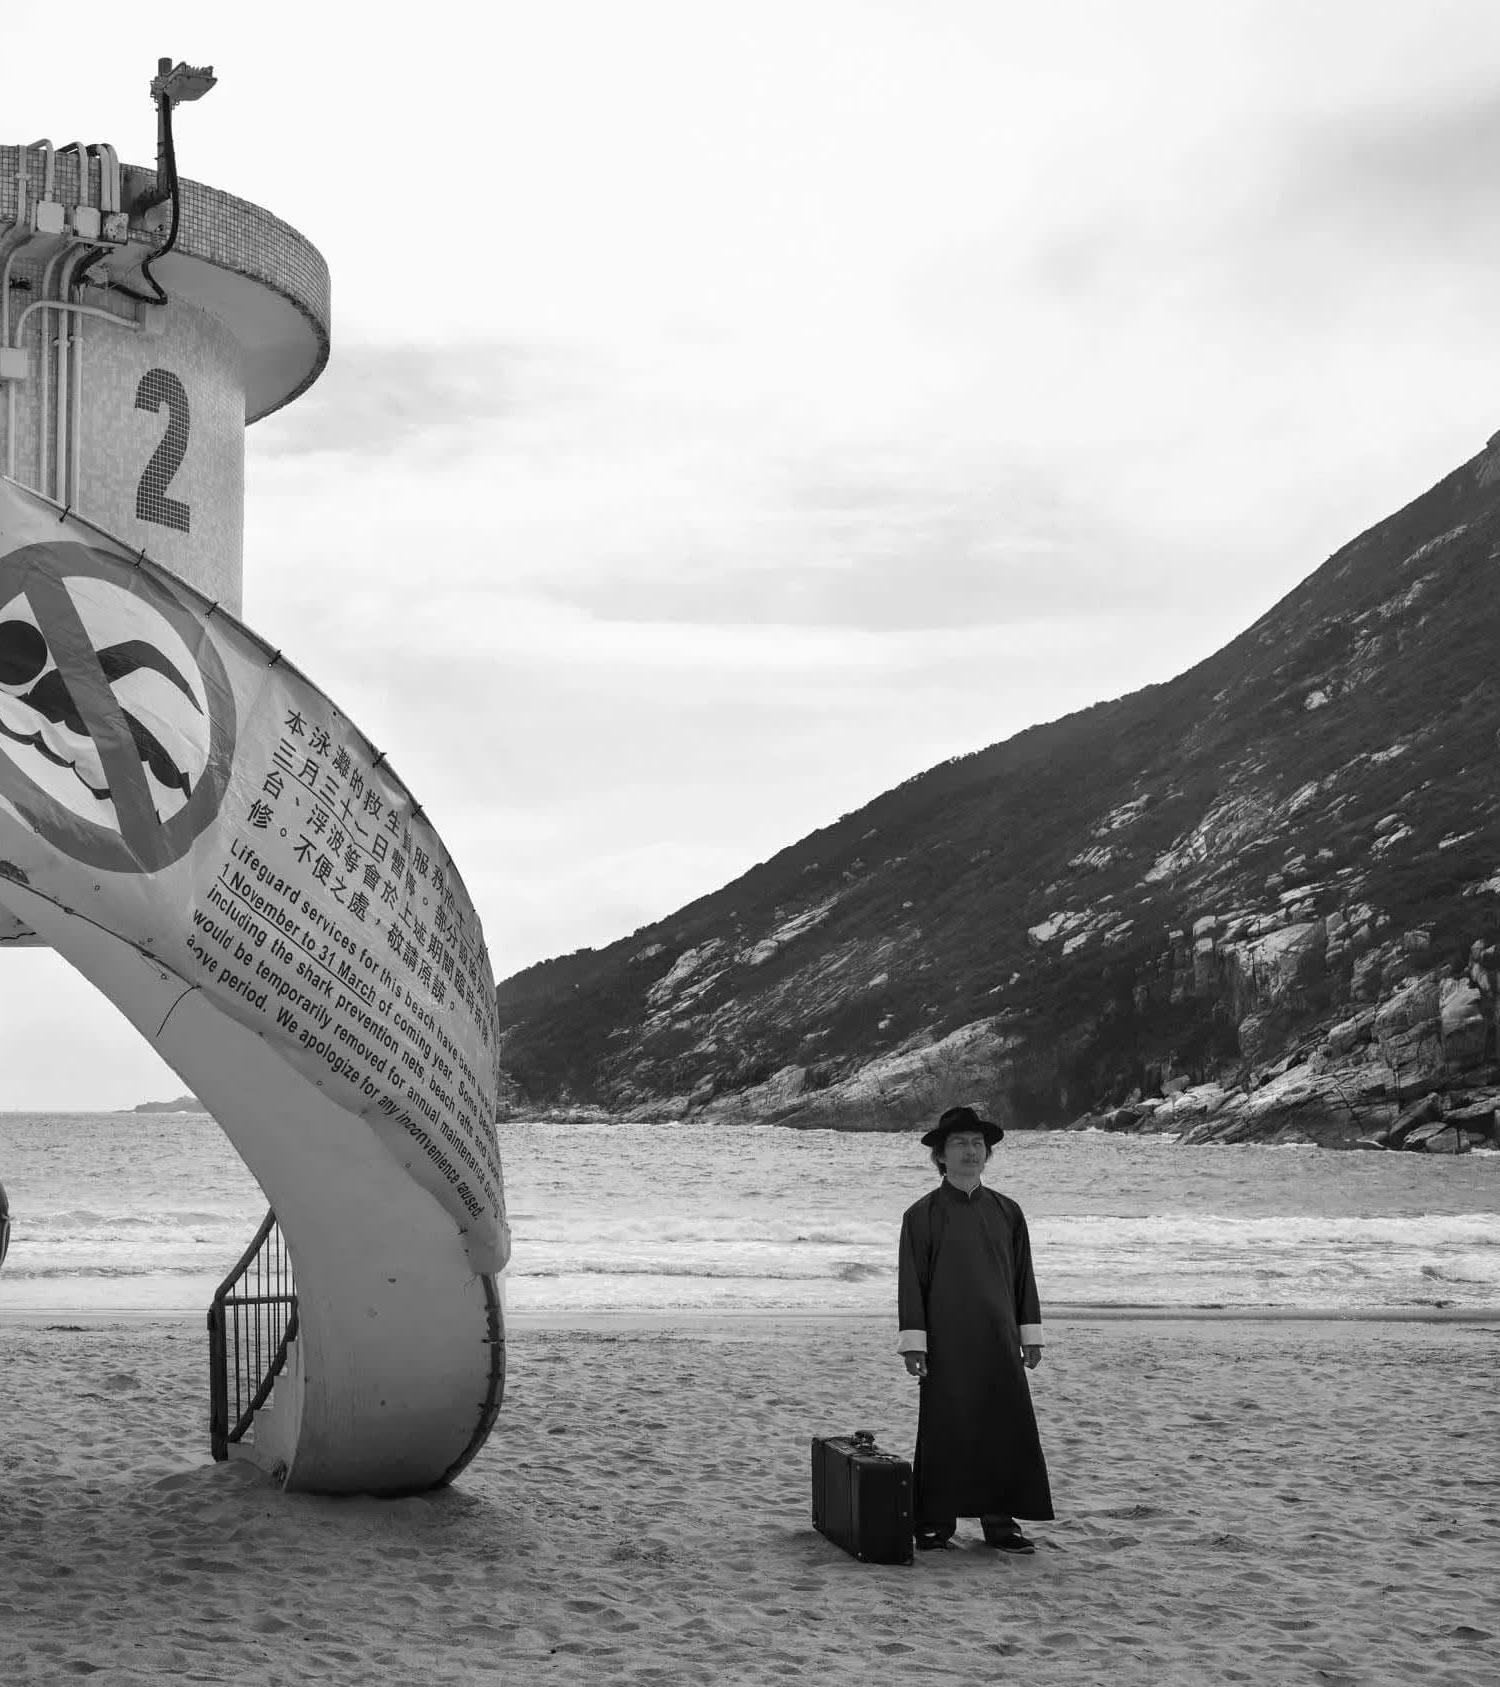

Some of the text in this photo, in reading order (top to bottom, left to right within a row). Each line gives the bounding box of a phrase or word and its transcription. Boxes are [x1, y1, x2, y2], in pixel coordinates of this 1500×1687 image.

[134, 368, 190, 534] 2
[193, 909, 235, 950] would
[234, 942, 253, 966] be
[255, 960, 332, 1030] temporarily
[333, 1024, 388, 1073] removed
[388, 1066, 406, 1089] for
[407, 1086, 440, 1125] annual
[206, 884, 267, 947] including
[271, 938, 293, 965] the
[296, 961, 335, 998] shark
[335, 994, 400, 1054] prevention
[401, 1050, 425, 1084] nets,
[429, 1075, 455, 1113] beach
[457, 1110, 474, 1138] rafts
[217, 968, 268, 1013] period.
[276, 1007, 298, 1033] We
[300, 1029, 360, 1083] apologize
[359, 1076, 380, 1099] for
[378, 1095, 400, 1116] any
[395, 1110, 460, 1185] inconvenience
[222, 863, 231, 877] 1
[230, 872, 300, 936] November
[301, 931, 316, 951] to
[318, 945, 336, 967] 31
[337, 960, 377, 1001] March
[379, 1000, 393, 1016] of
[394, 1013, 432, 1059] coming
[432, 1053, 453, 1084] year.
[458, 1081, 478, 1116] Some
[231, 838, 477, 1088] Lifeguard services for this beach have been
